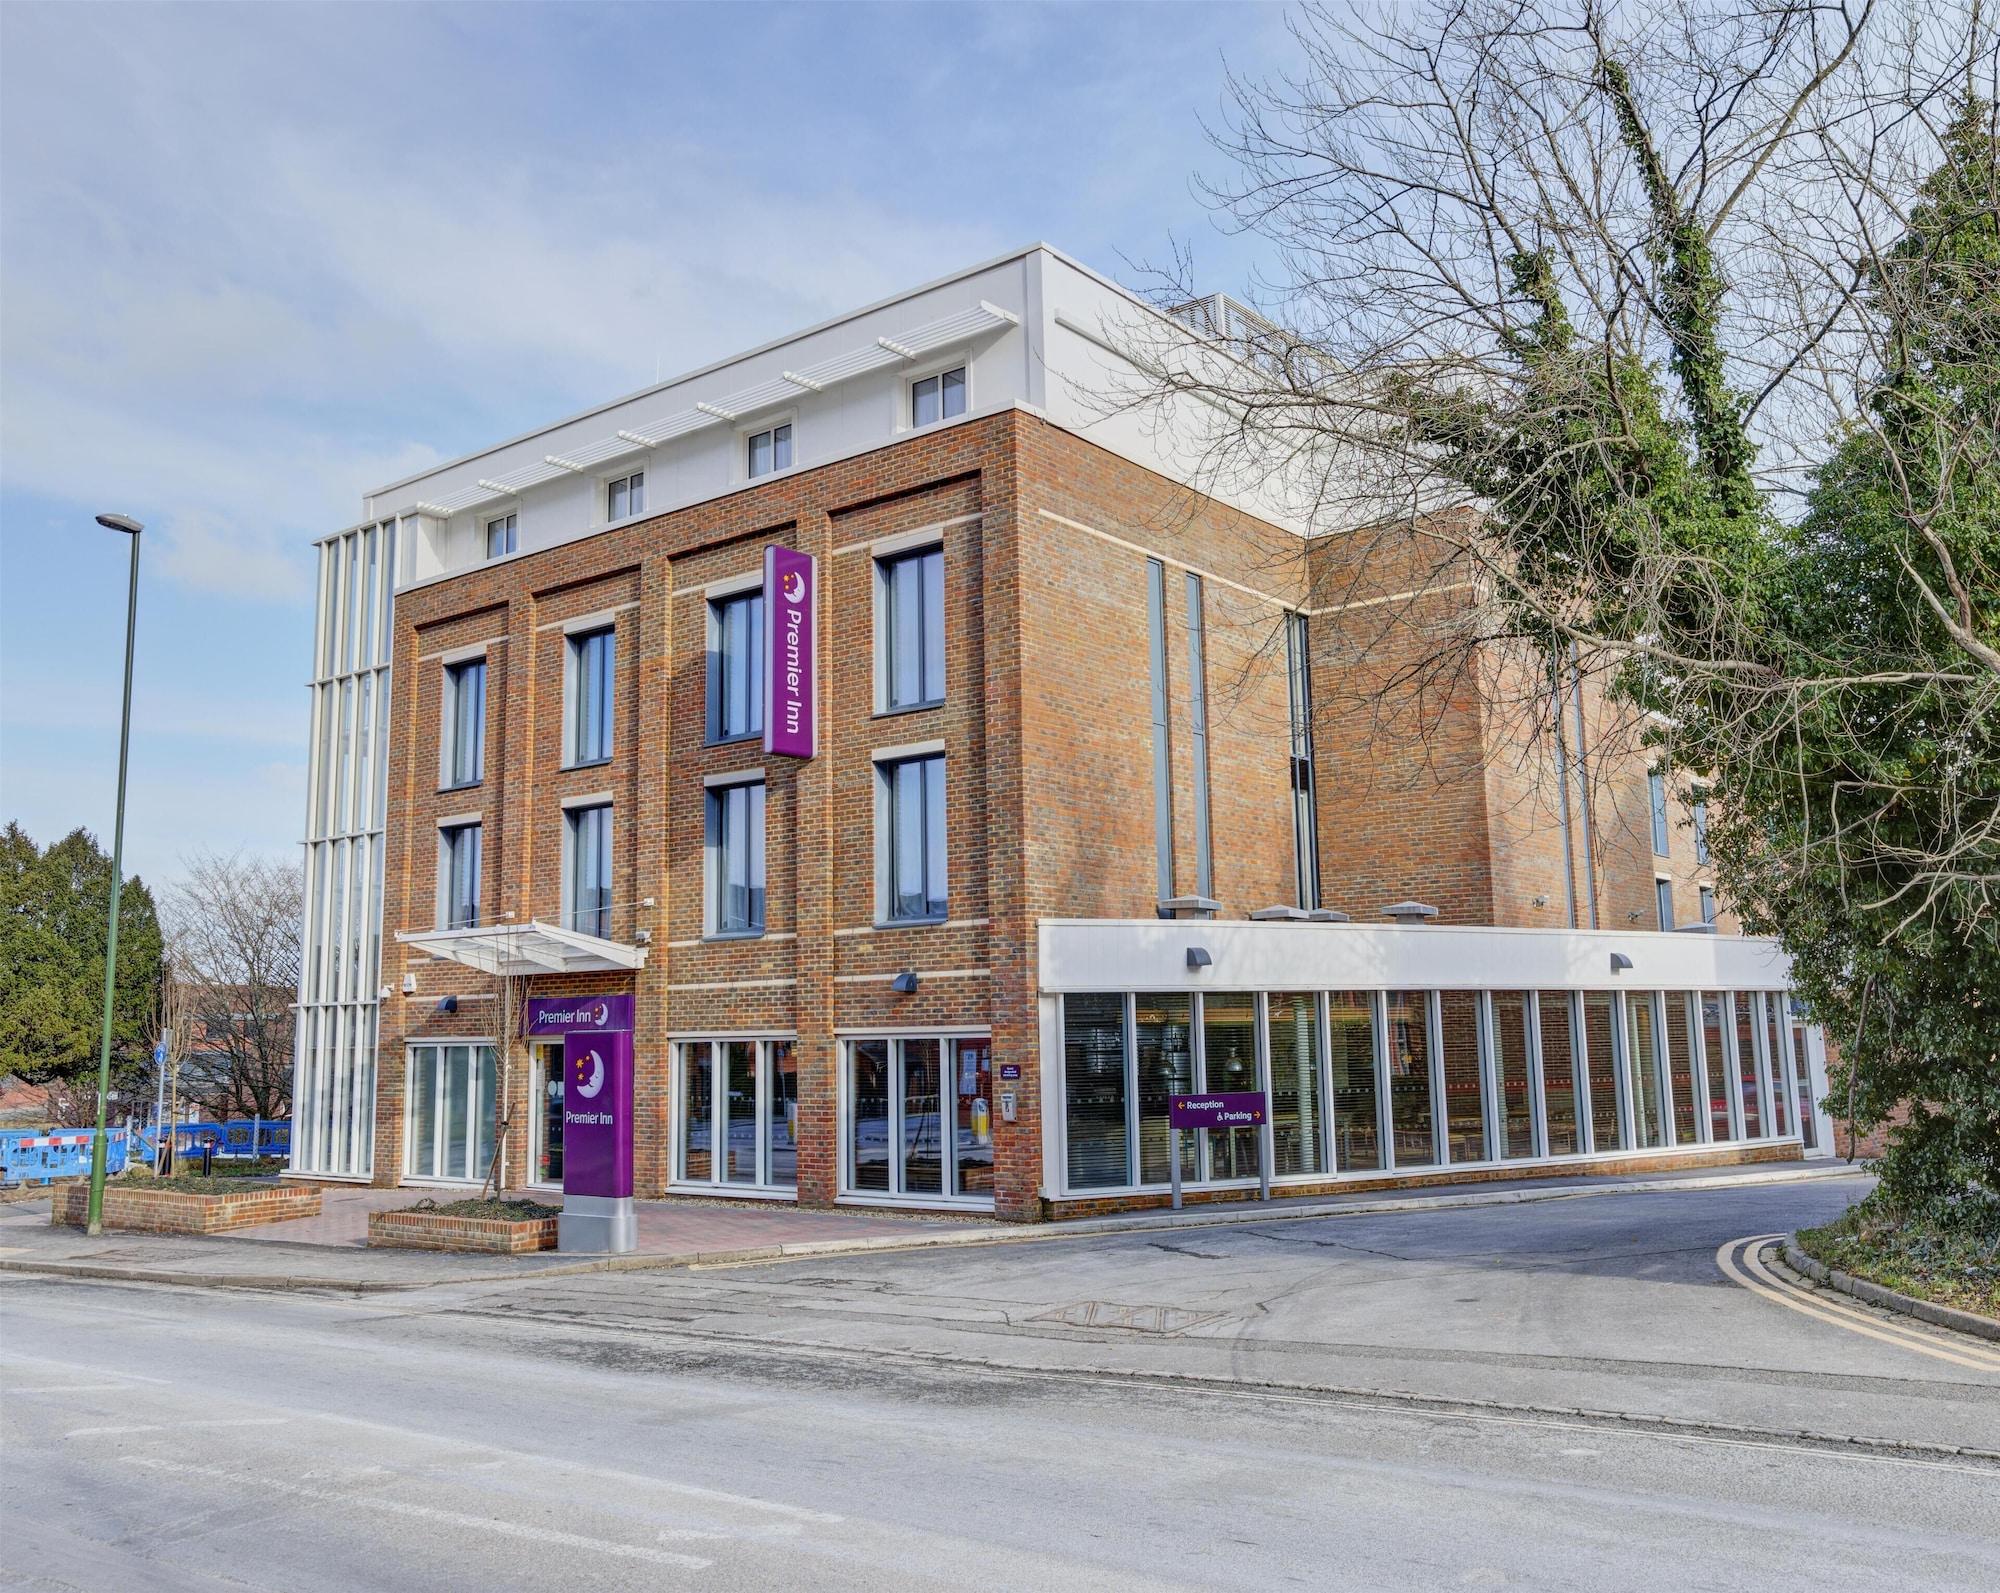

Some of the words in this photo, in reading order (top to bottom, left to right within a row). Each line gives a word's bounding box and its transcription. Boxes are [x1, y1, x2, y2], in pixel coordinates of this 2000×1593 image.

[786, 608, 802, 697] Premier
[786, 700, 802, 734] Inn
[538, 1010, 575, 1024] Premier
[576, 1008, 591, 1023] Inn
[1186, 1100, 1224, 1110] Reception
[565, 1111, 599, 1125] Premier
[599, 1112, 613, 1125] Inn
[1224, 1111, 1252, 1121] Parking
